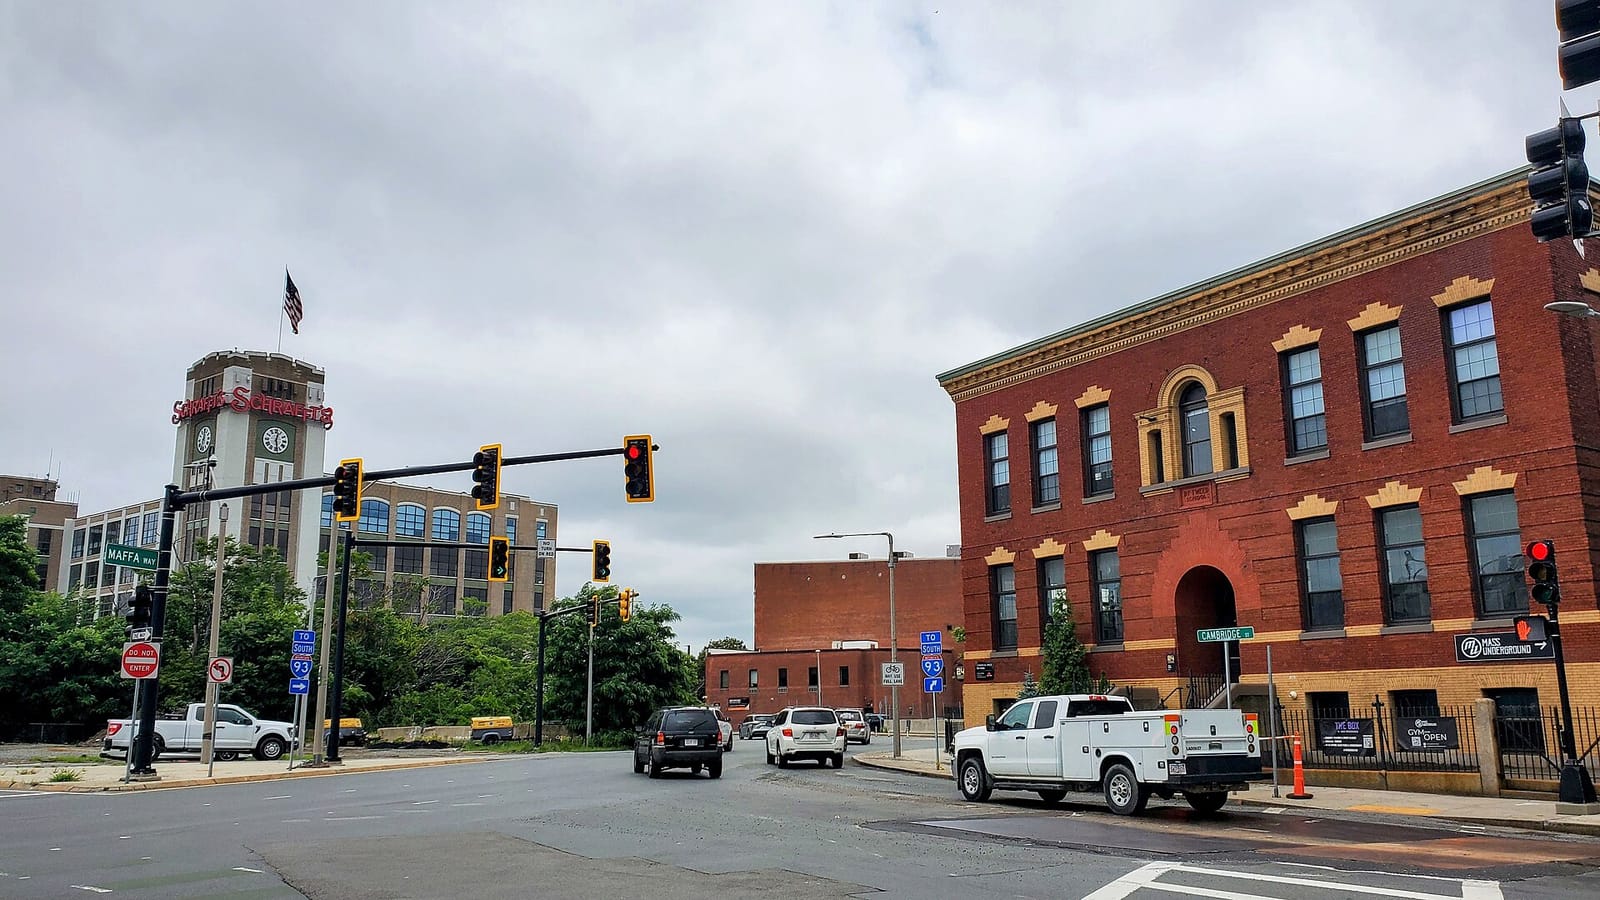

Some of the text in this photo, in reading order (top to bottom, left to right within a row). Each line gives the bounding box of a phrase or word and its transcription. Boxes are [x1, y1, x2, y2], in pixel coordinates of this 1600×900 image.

[230, 386, 333, 428] SCHRAFFT'S
[108, 548, 156, 565] MAFFA WAY
[300, 632, 309, 640] TO
[1201, 629, 1242, 640] CAMBRIDGE
[1481, 637, 1500, 647] MASS
[293, 643, 312, 653] SOUTH
[922, 645, 940, 653] SOUTH
[1482, 644, 1531, 655] UNDERGROUND
[293, 661, 309, 672] 93
[925, 661, 940, 672] 93
[1334, 721, 1360, 730] THE BOX
[1407, 728, 1424, 736] GYM
[1423, 733, 1447, 741] OPEN
